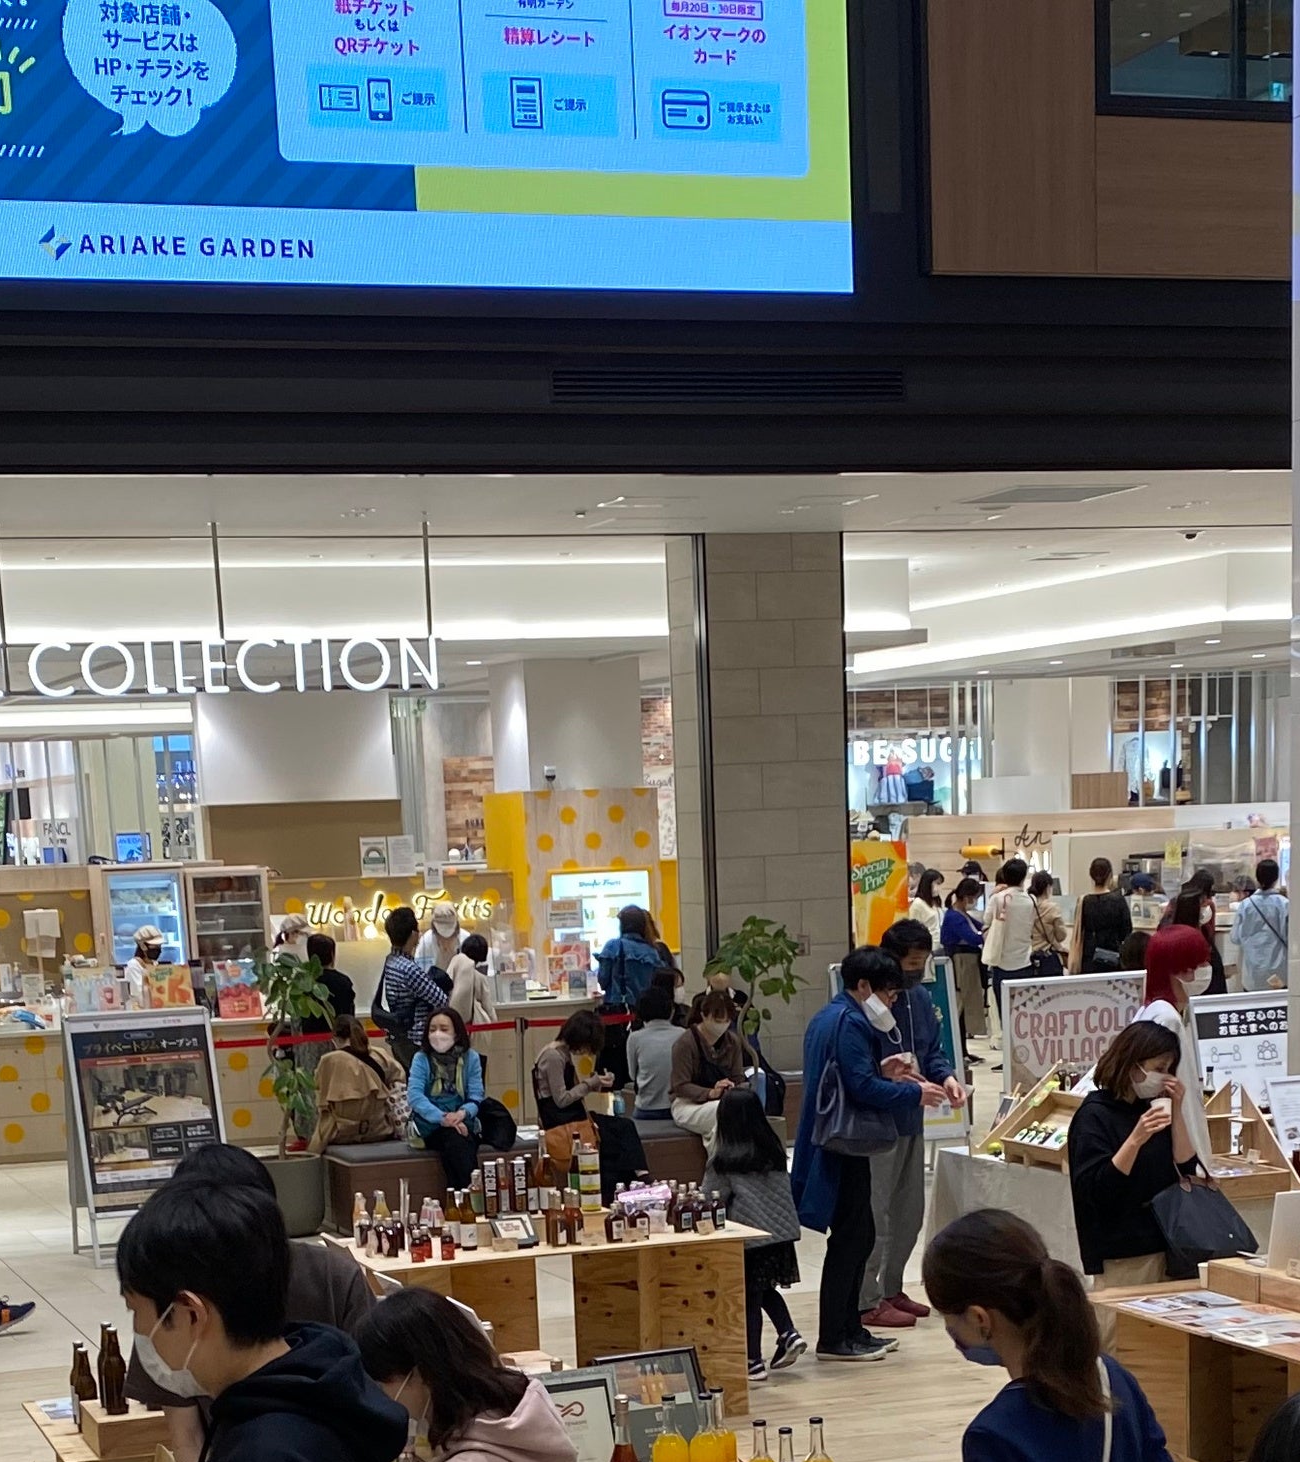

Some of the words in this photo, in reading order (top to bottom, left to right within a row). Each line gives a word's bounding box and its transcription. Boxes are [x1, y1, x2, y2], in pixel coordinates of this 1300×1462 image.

[354, 19, 399, 32] もしくは
[663, 25, 766, 44] イオンマークの
[103, 30, 198, 52] サービスは
[335, 37, 419, 56] QRチケット
[504, 26, 595, 48] 精算レシート
[693, 49, 737, 65] カード
[94, 57, 209, 81] HP・チラシを
[400, 92, 435, 106] ご提示
[554, 98, 587, 111] ご提示
[79, 234, 187, 256] ARIAKE
[200, 237, 315, 259] GARDEN
[28, 636, 439, 697] COLLECTION
